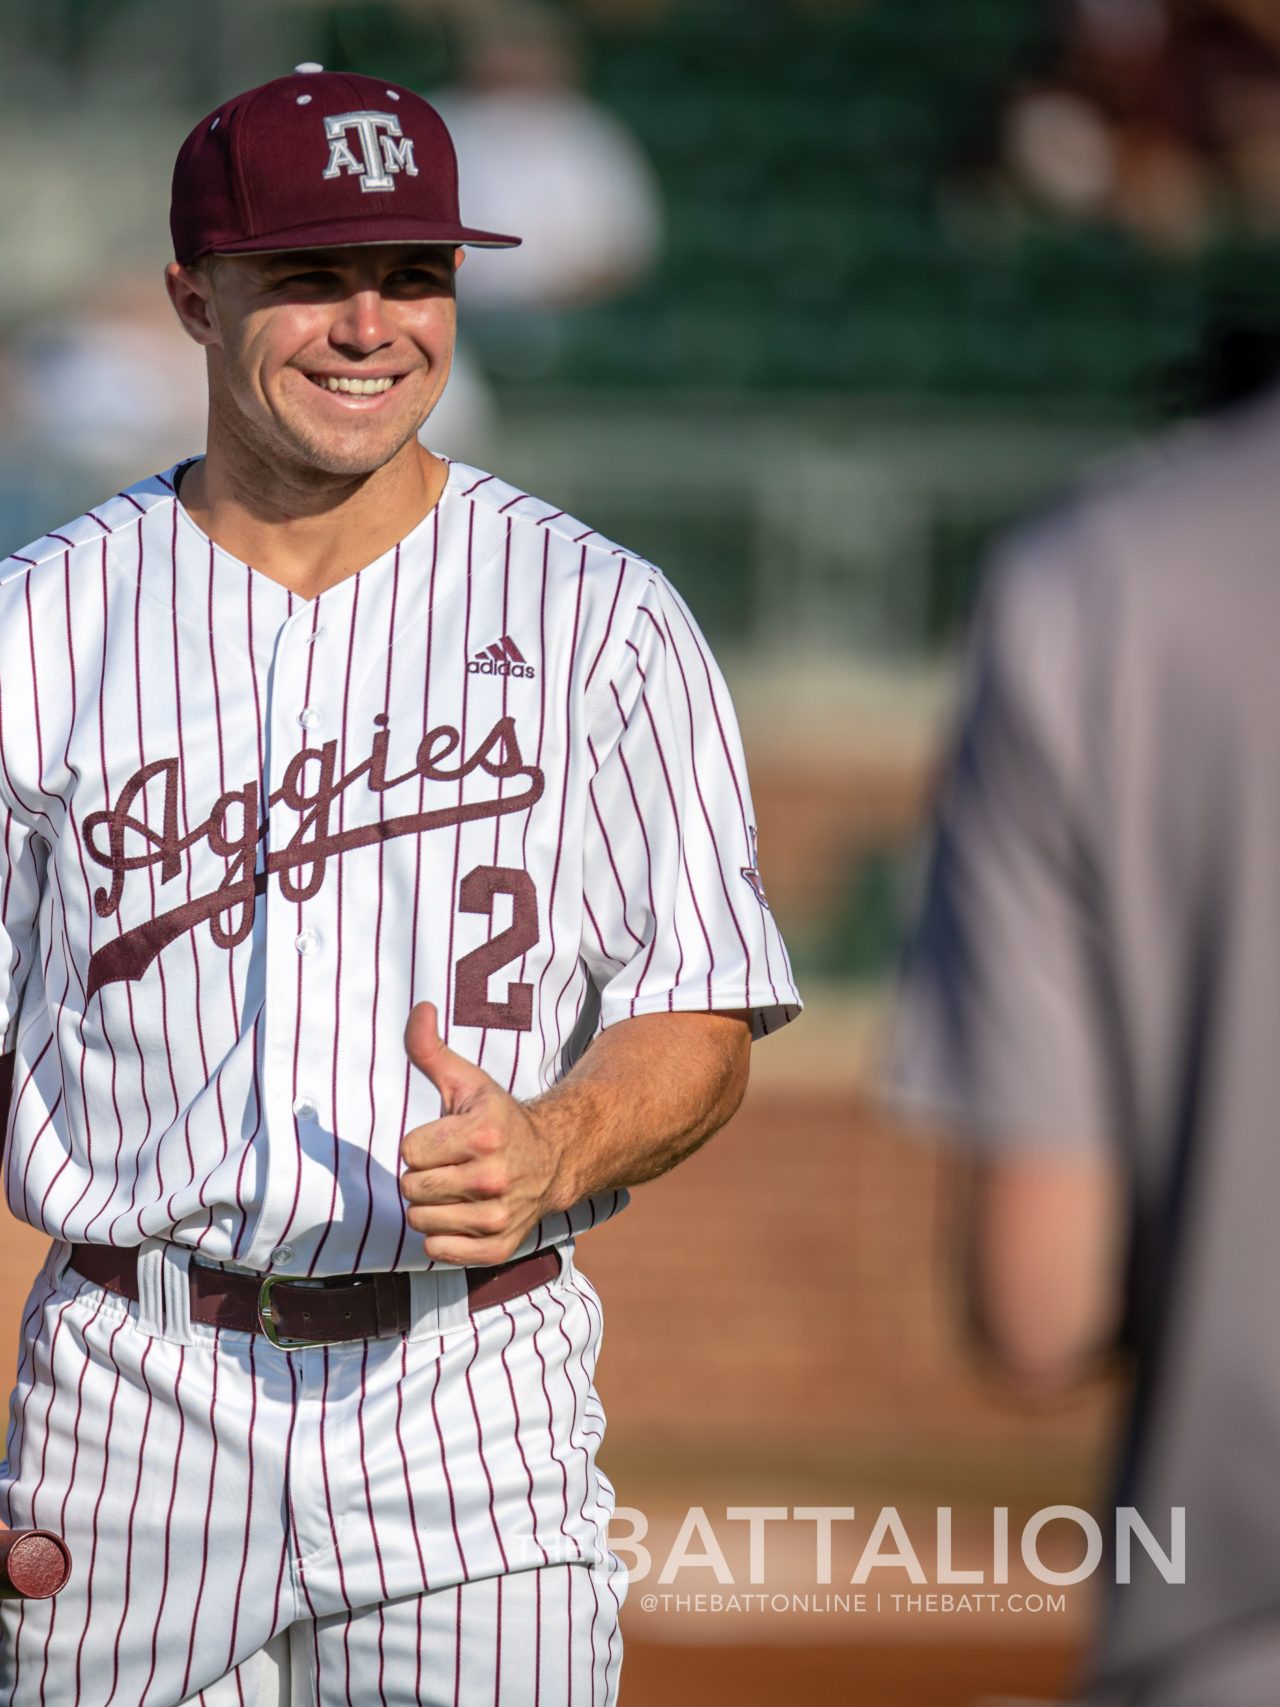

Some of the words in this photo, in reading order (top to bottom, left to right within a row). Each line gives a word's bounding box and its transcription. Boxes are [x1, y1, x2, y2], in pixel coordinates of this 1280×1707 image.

[466, 658, 535, 679] adidas
[82, 712, 545, 950] Aggies
[453, 864, 540, 1032] 2
